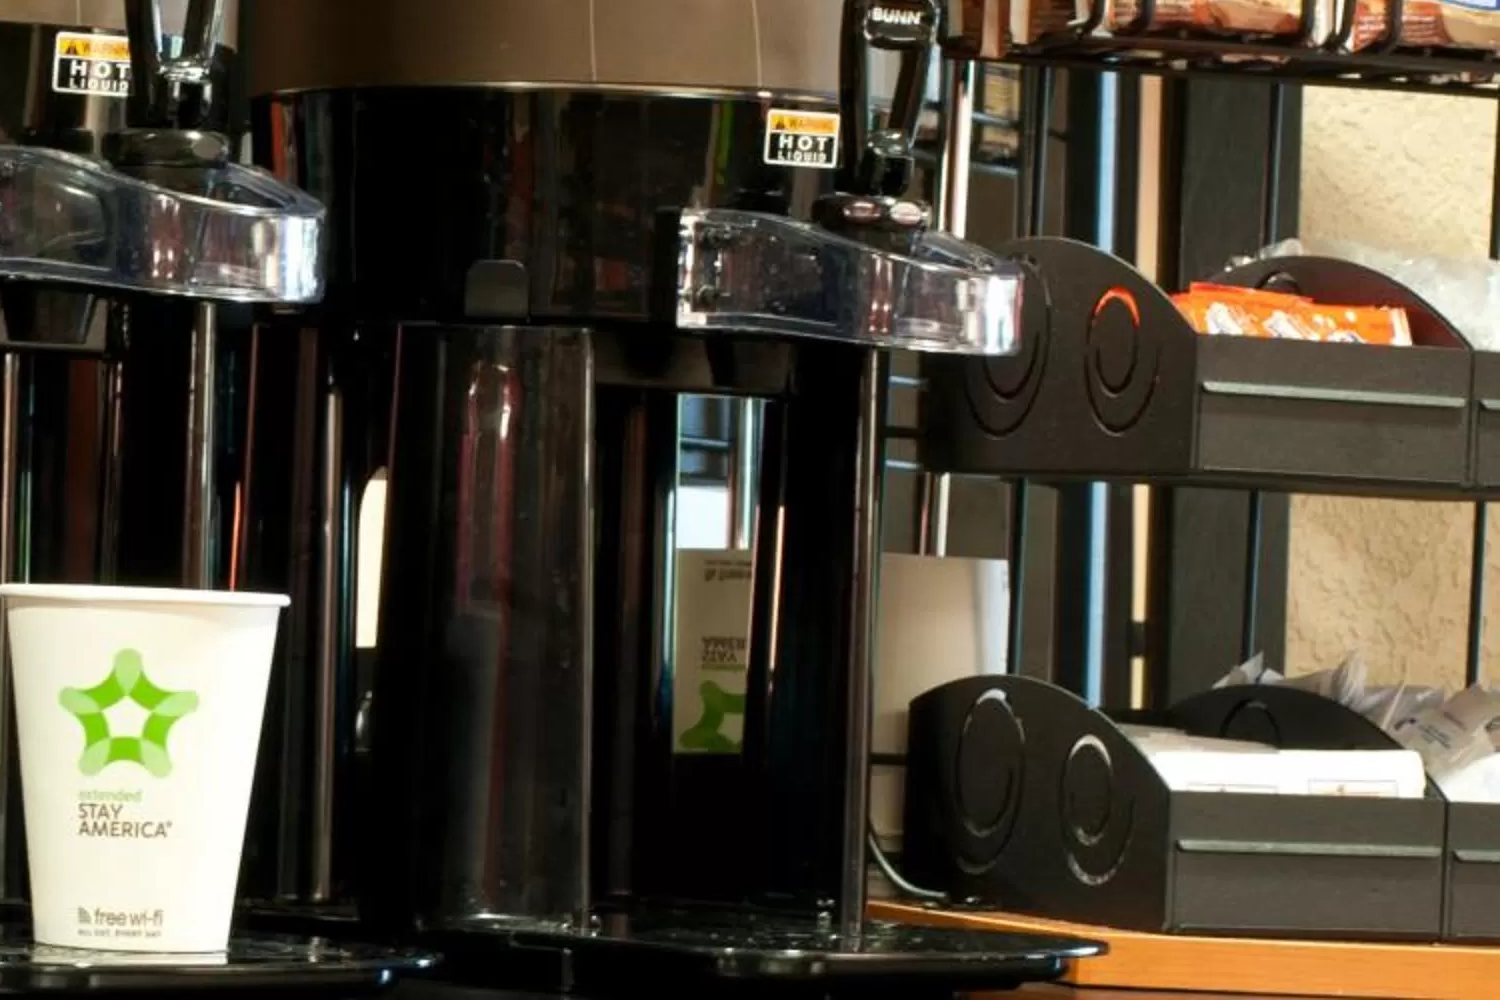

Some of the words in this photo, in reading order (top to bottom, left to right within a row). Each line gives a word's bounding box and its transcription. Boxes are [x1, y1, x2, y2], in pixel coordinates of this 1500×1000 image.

[872, 7, 922, 25] BUNN
[70, 59, 131, 79] HOT
[69, 77, 129, 93] LIQUID
[778, 133, 828, 151] HOT
[777, 150, 827, 163] LIQUID
[78, 803, 124, 820] STAY
[78, 820, 169, 838] AMERICA
[94, 906, 128, 926] free
[129, 908, 164, 928] wi-fi
